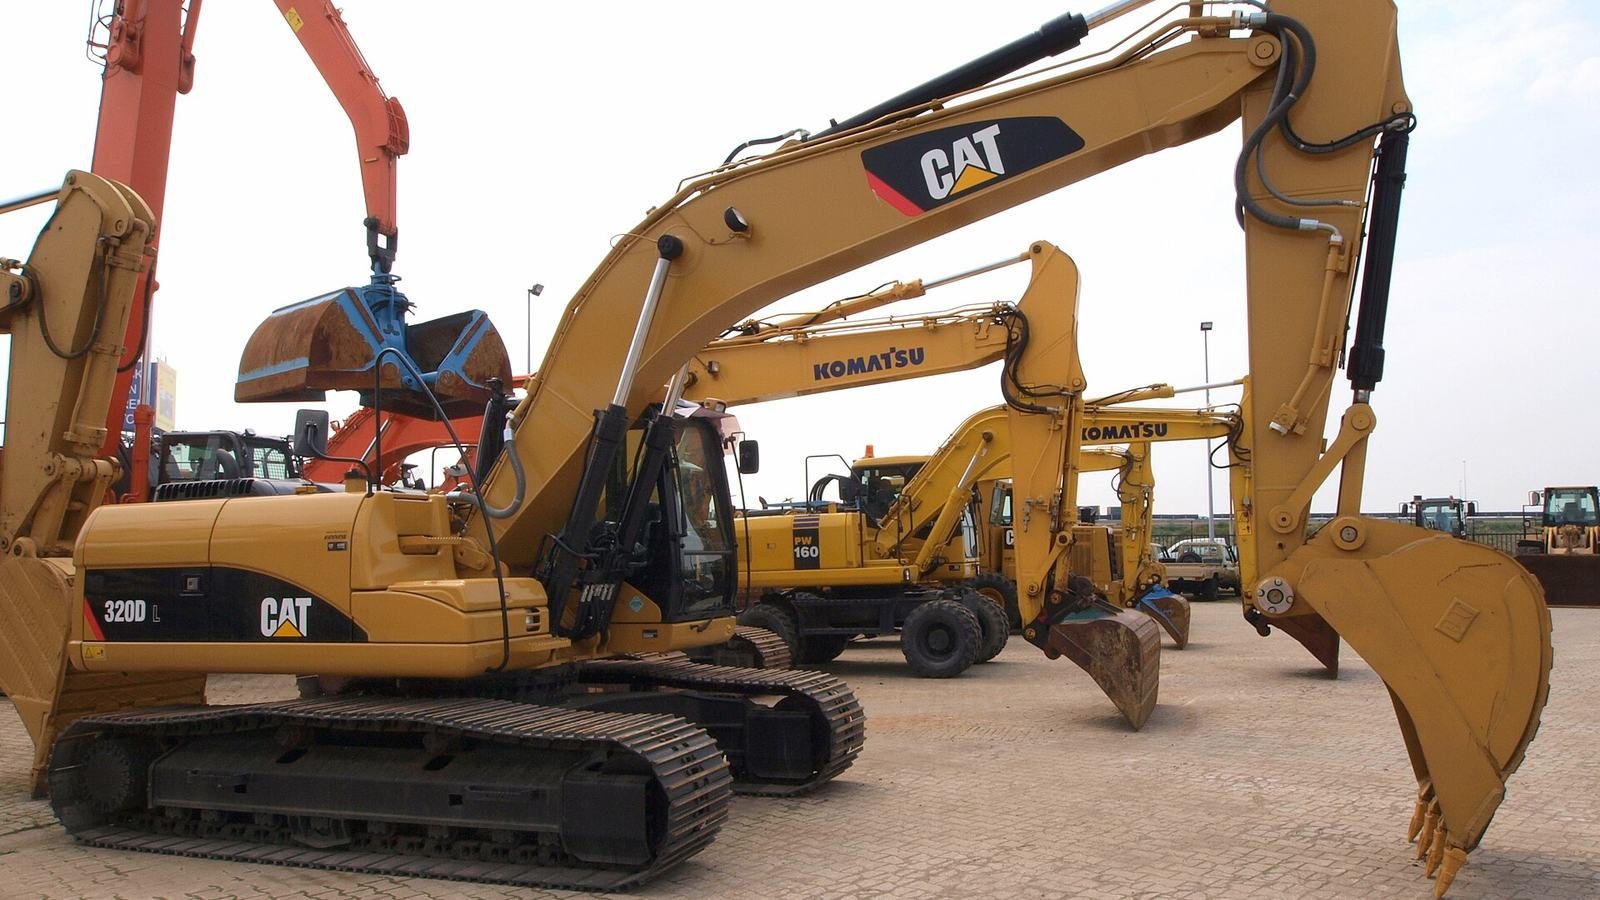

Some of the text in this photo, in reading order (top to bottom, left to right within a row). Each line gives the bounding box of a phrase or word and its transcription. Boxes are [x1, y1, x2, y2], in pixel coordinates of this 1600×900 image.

[920, 123, 1005, 200] CAT
[813, 347, 925, 381] KOMATSU
[794, 536, 813, 545] PW
[794, 546, 819, 558] 160
[104, 599, 161, 623] 320D L
[260, 597, 312, 637] CAT
